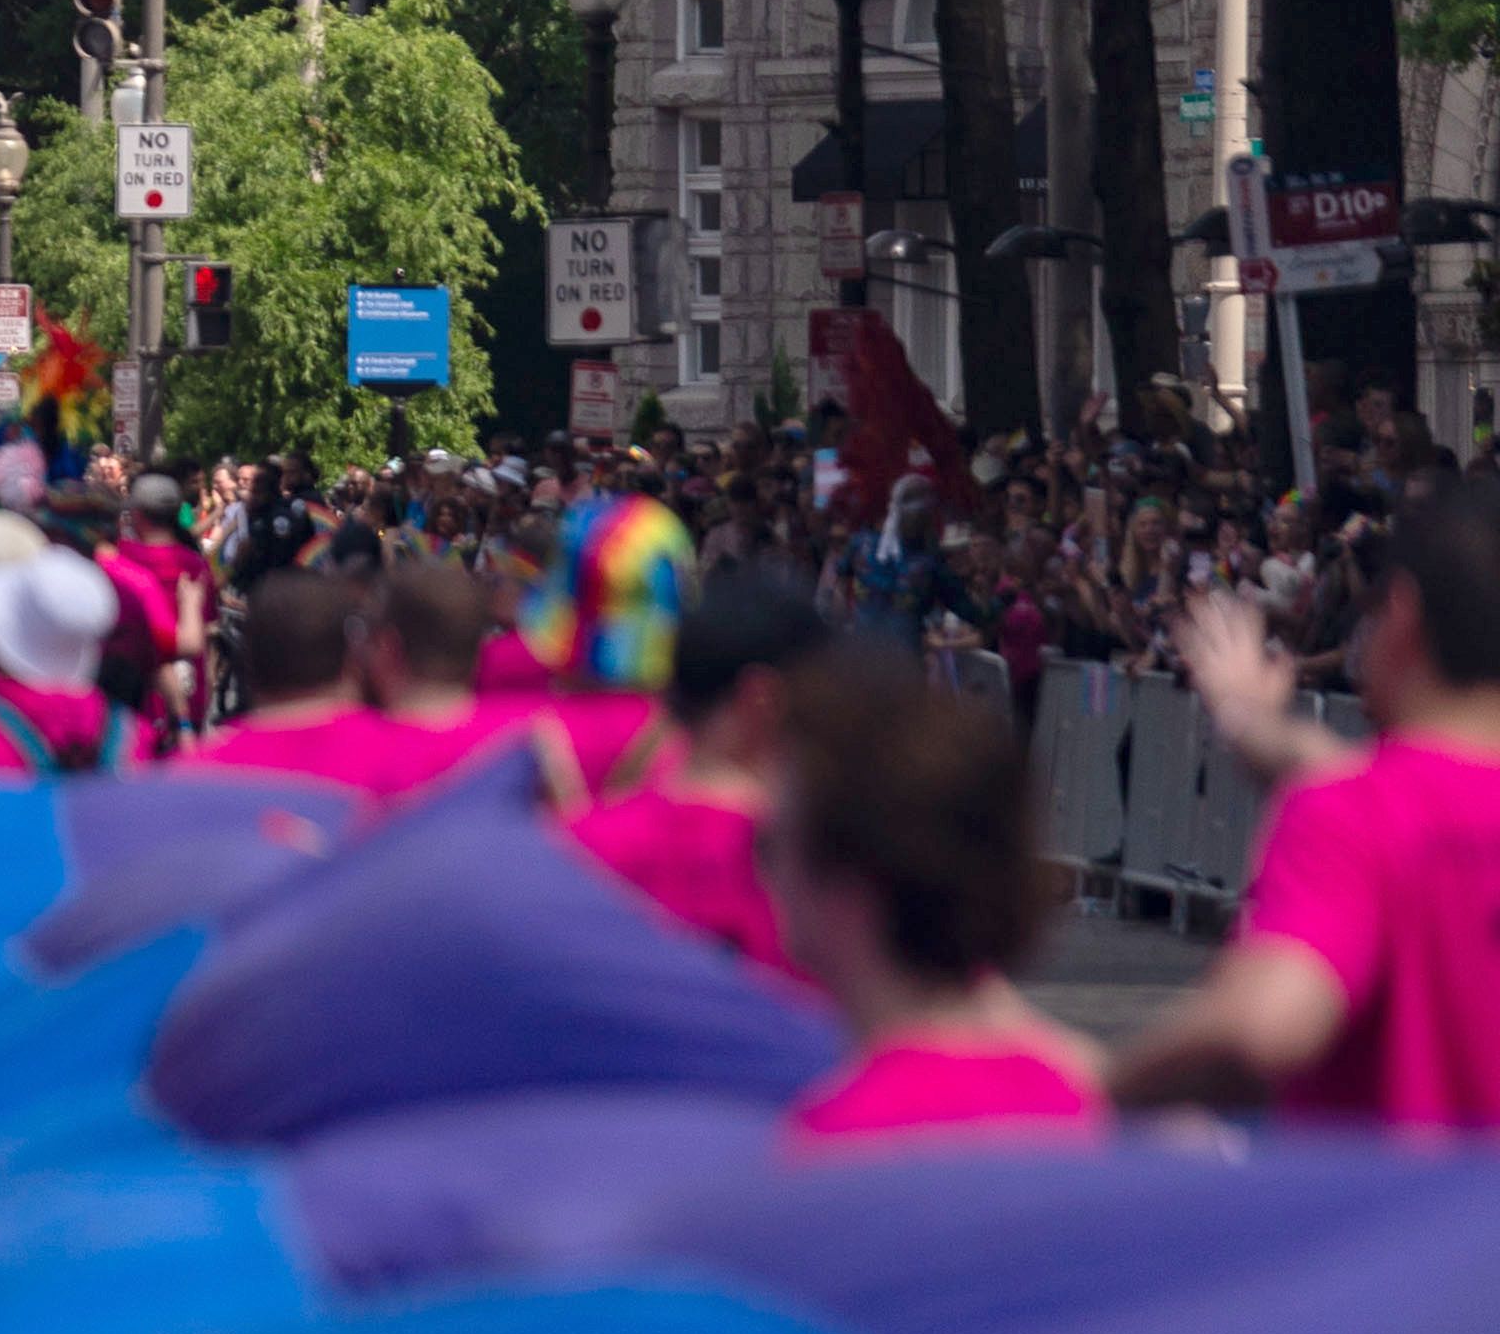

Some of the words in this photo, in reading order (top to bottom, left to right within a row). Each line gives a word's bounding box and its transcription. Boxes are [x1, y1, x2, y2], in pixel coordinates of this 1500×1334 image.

[139, 132, 169, 148] NO
[133, 153, 175, 167] TURN
[123, 172, 145, 186] ON
[152, 172, 184, 186] RED
[571, 230, 608, 252] NO
[567, 259, 615, 277] TURN
[556, 283, 581, 302] ON
[589, 283, 626, 302] RED
